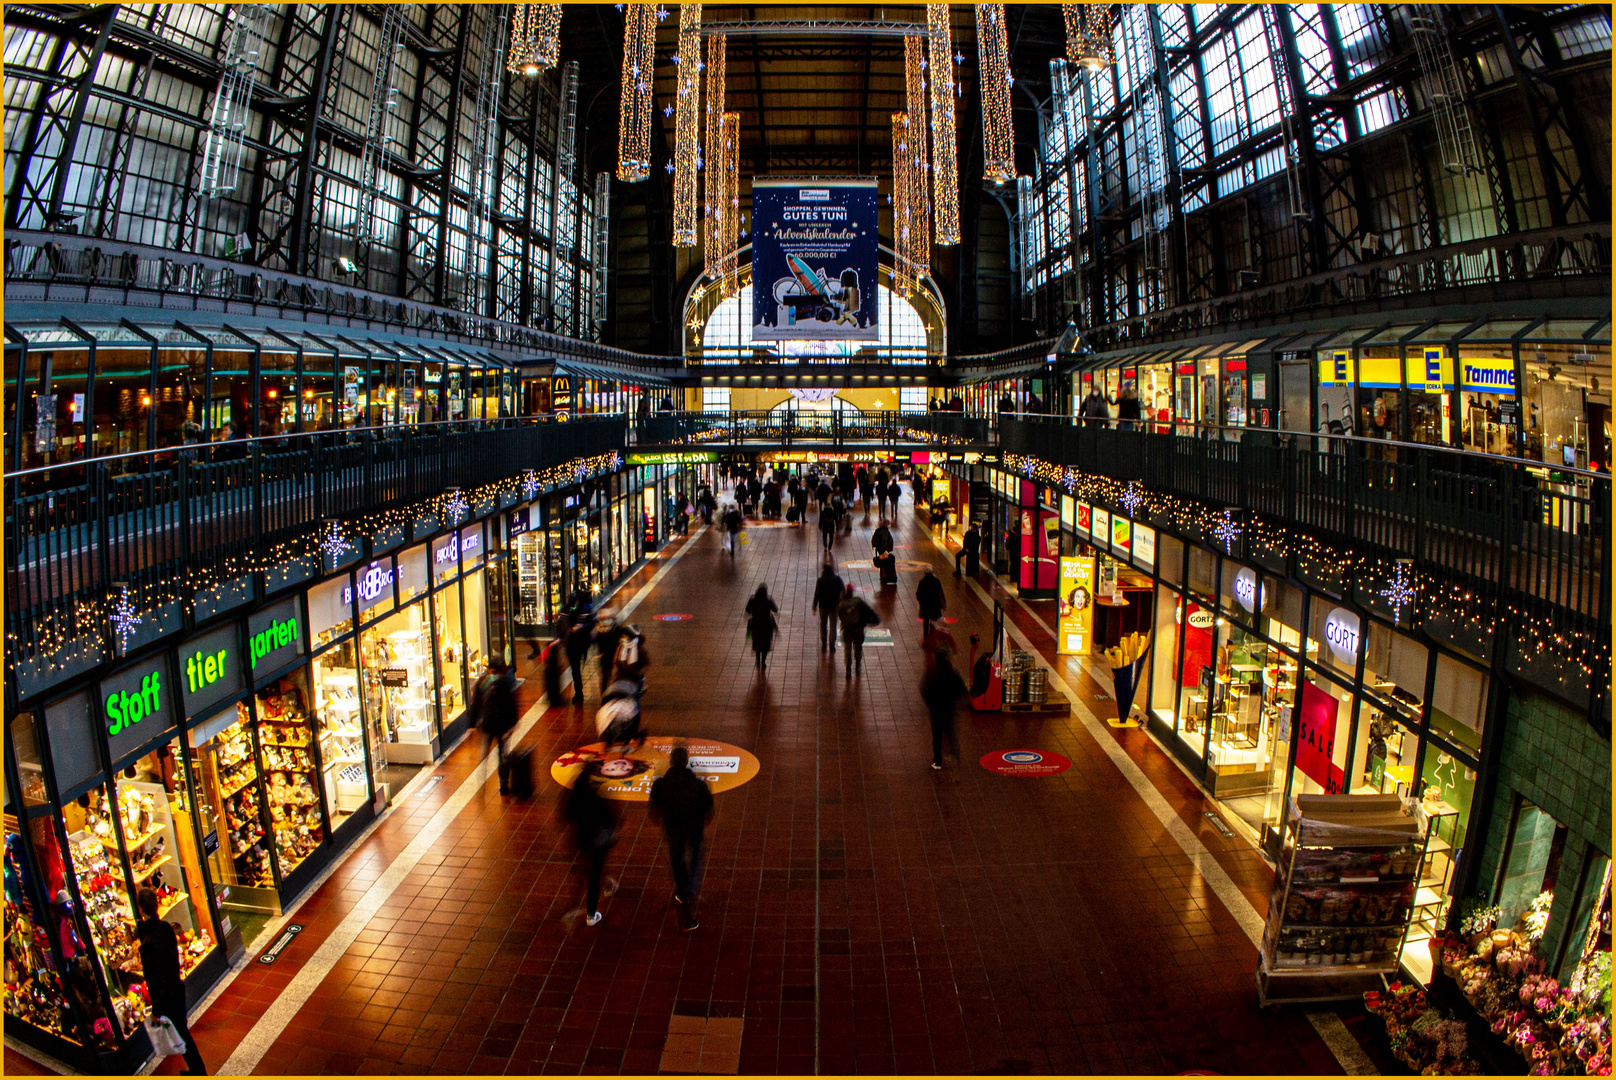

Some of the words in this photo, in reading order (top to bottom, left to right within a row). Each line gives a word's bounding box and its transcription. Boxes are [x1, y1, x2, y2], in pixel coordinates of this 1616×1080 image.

[783, 212, 818, 221] GUTES
[821, 212, 848, 221] TUN!
[773, 228, 857, 240] Adventskalender
[106, 671, 160, 736] Stoff
[186, 649, 226, 693] tier
[1300, 722, 1333, 759] SALE
